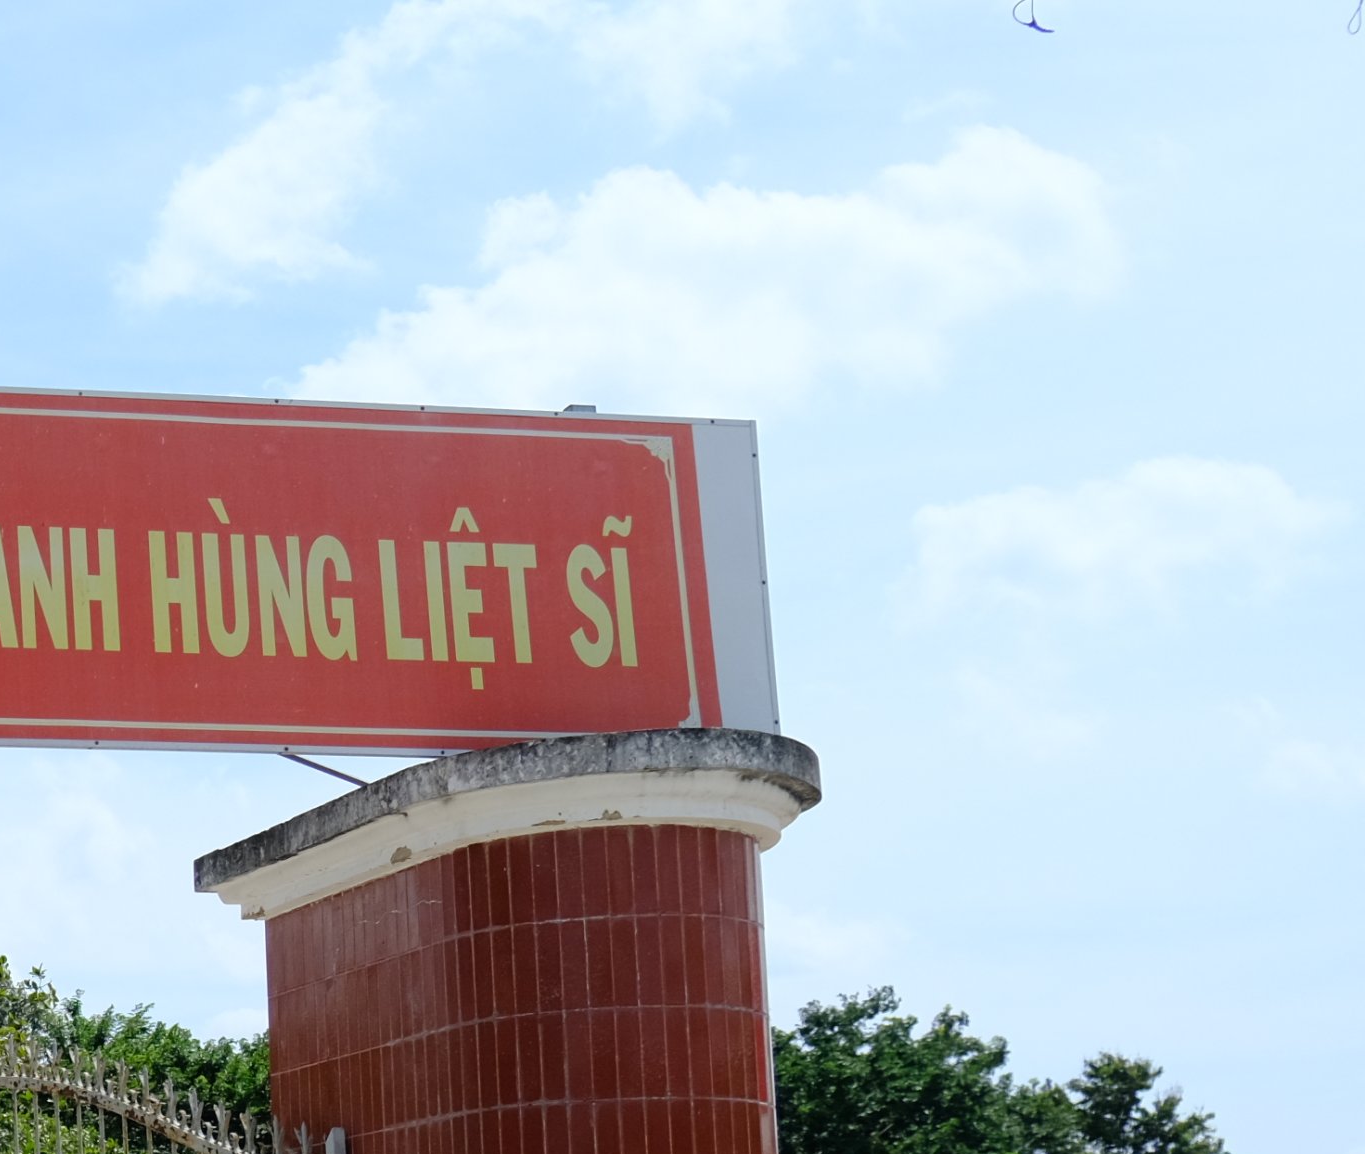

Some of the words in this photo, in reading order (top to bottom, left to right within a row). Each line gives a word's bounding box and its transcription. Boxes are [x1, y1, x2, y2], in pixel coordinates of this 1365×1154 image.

[148, 497, 358, 661] HÙNG
[378, 507, 537, 690] LIỆT
[566, 515, 638, 668] SĨ
